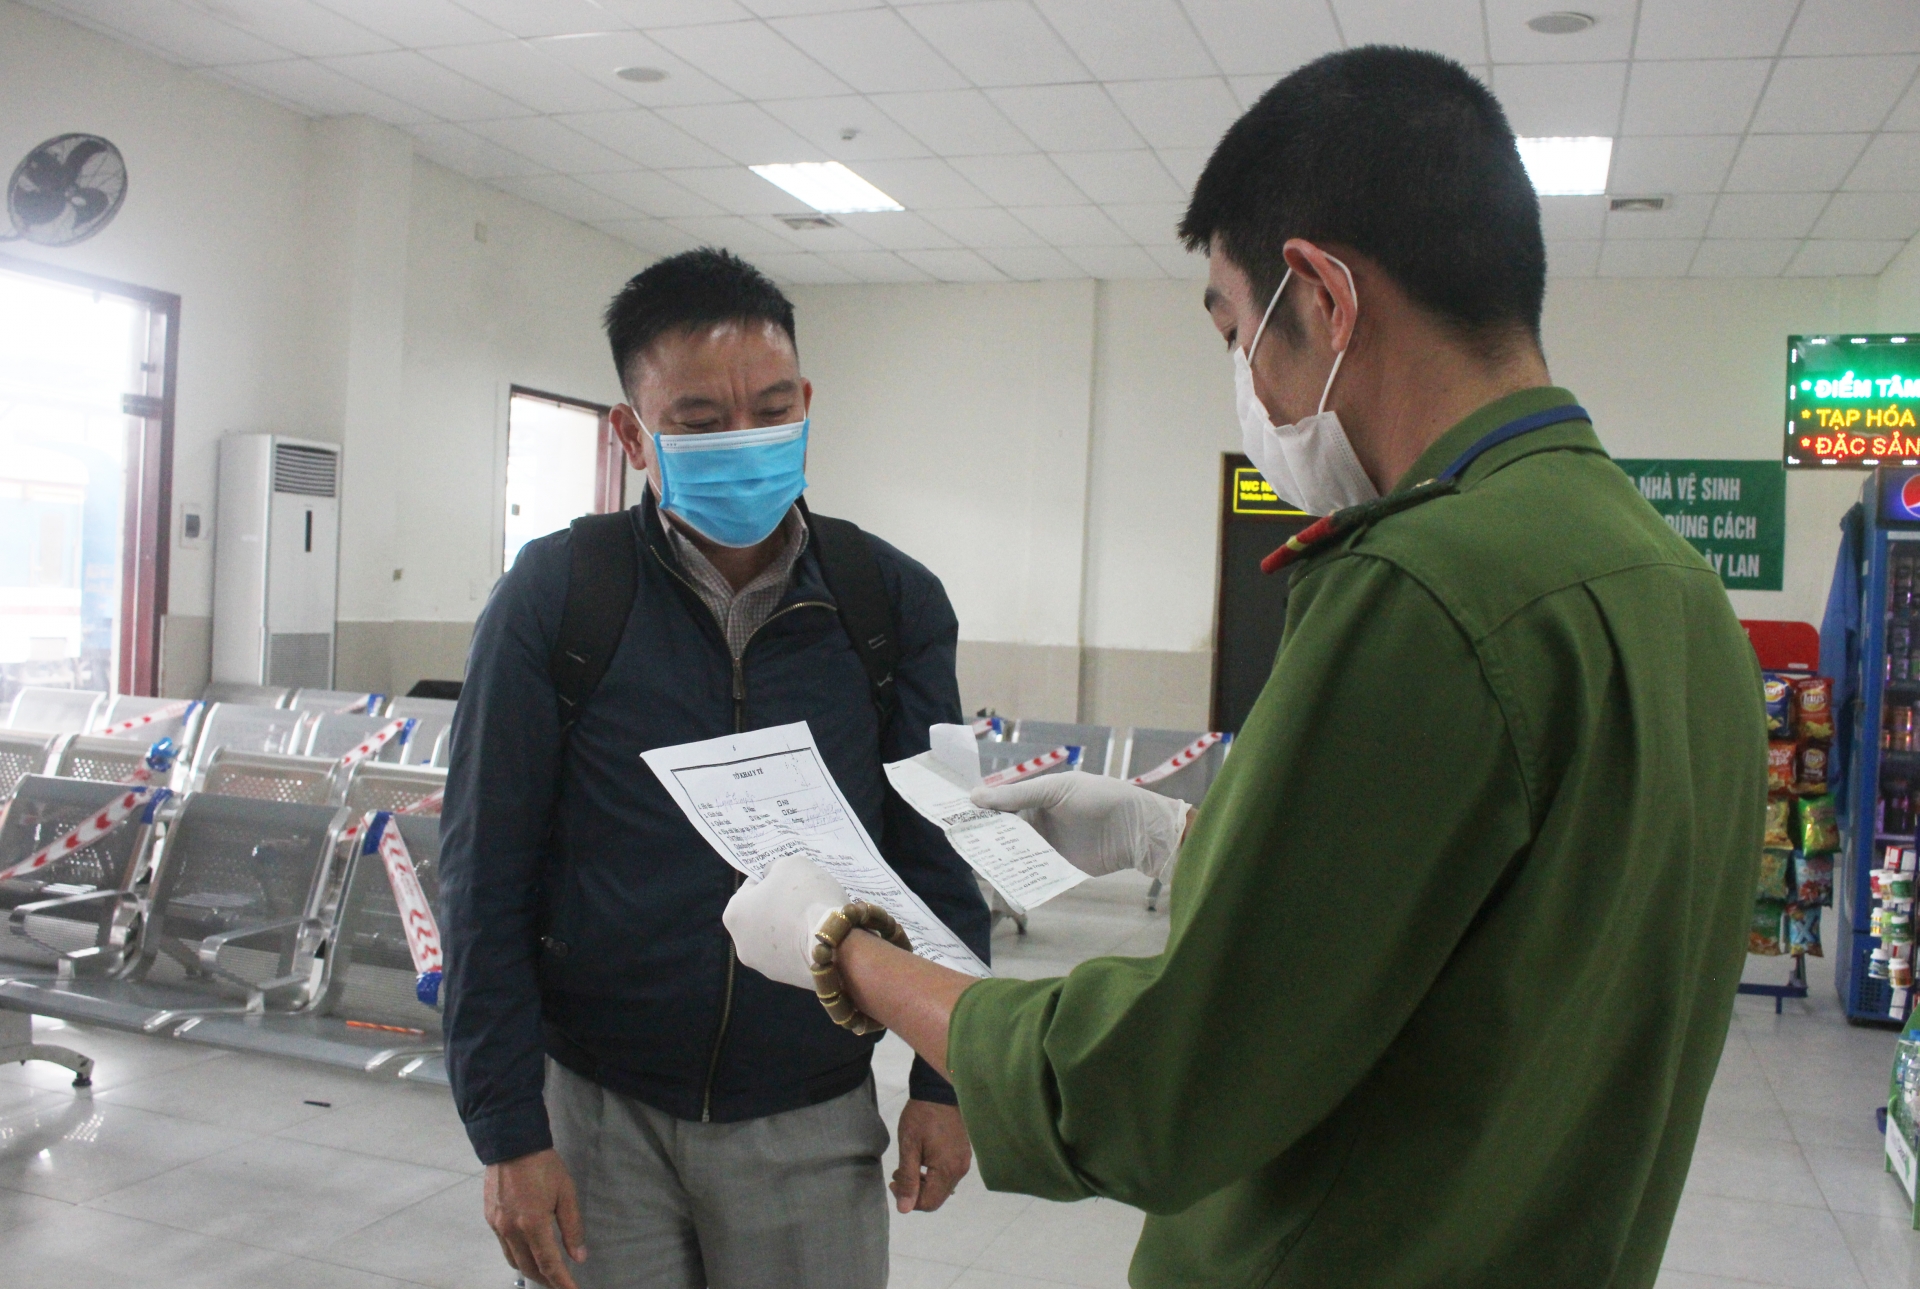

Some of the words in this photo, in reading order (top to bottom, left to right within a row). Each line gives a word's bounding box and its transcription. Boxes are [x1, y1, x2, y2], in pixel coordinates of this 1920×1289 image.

[1875, 374, 1920, 398] TÂM
[1816, 408, 1861, 431] TẠP
[1866, 403, 1916, 427] HÓA
[1815, 432, 1866, 459] ĐẶC
[1872, 430, 1920, 455] SẢN
[1639, 471, 1673, 500] NHÀ
[1677, 472, 1697, 505] VỆ
[1701, 477, 1741, 501] SINH
[1713, 511, 1757, 539] CÁCH
[1728, 554, 1760, 577] LAN
